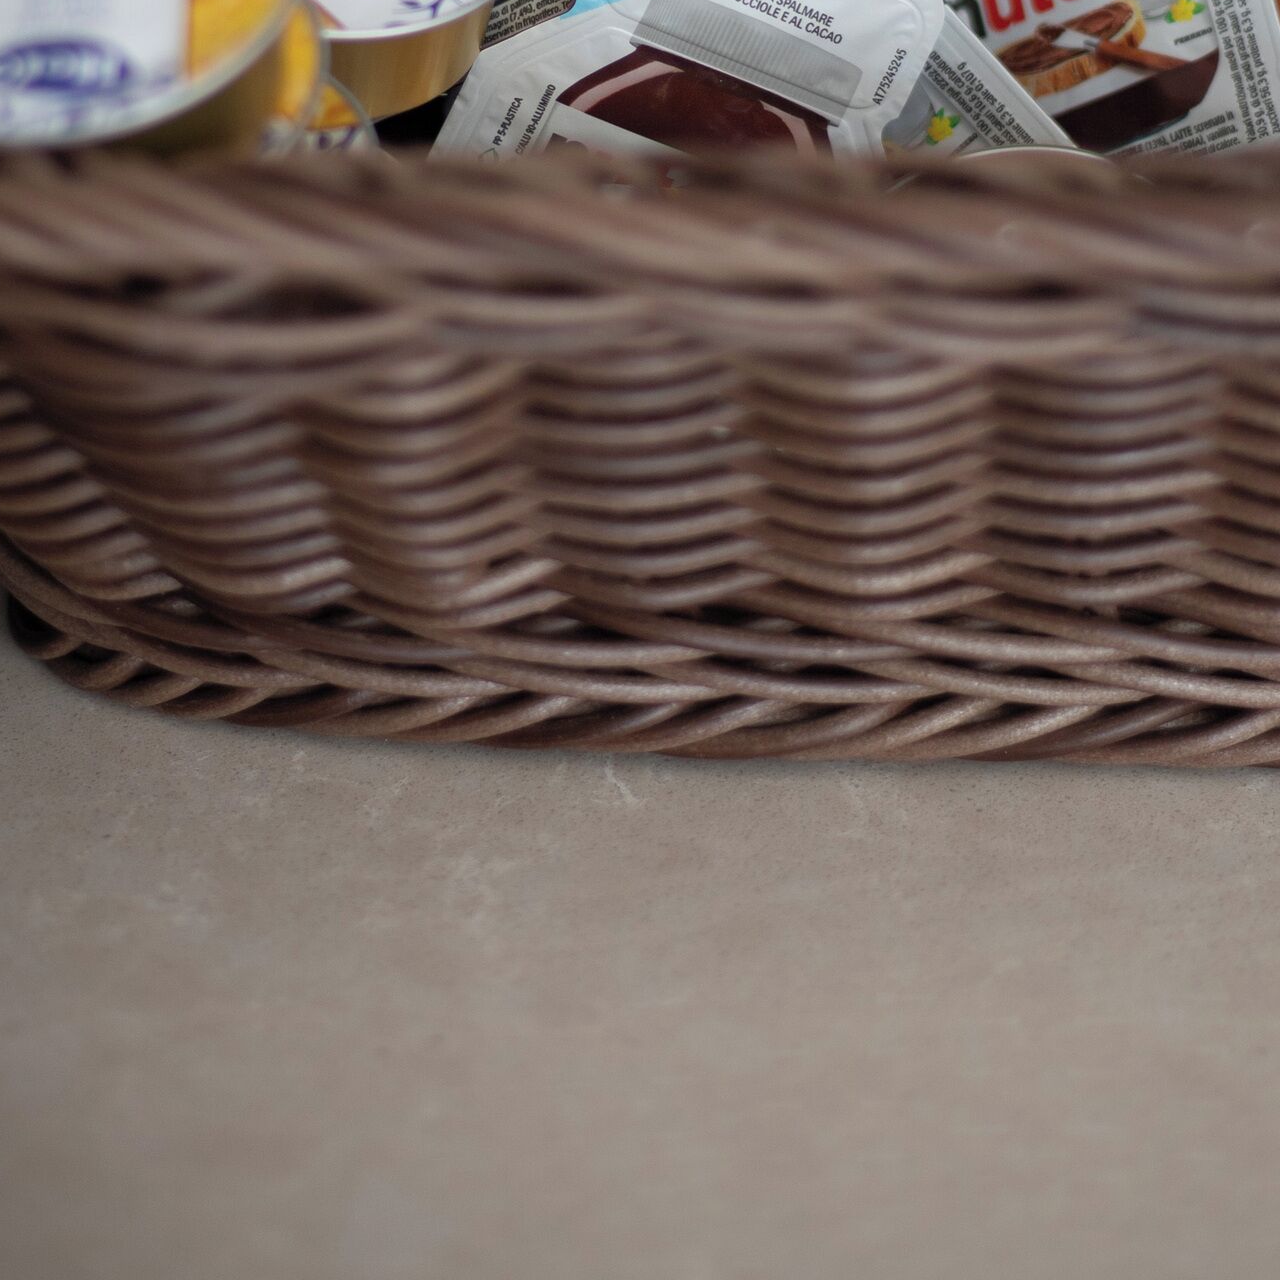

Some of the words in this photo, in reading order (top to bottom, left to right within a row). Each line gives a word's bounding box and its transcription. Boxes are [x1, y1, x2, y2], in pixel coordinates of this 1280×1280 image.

[780, 11, 790, 23] E
[788, 16, 803, 30] AL
[805, 22, 843, 45] CACAO
[1215, 17, 1228, 35] 100
[1241, 17, 1254, 33] 6,3
[1222, 36, 1234, 50] per
[1234, 35, 1250, 61] grassi
[872, 49, 907, 105] AT75245245
[525, 84, 556, 135] 90-ALLUMINIO
[1250, 98, 1261, 108] di
[492, 135, 502, 146] PP
[497, 98, 523, 136] 5-PLASTICA
[1169, 126, 1193, 142] LATTE
